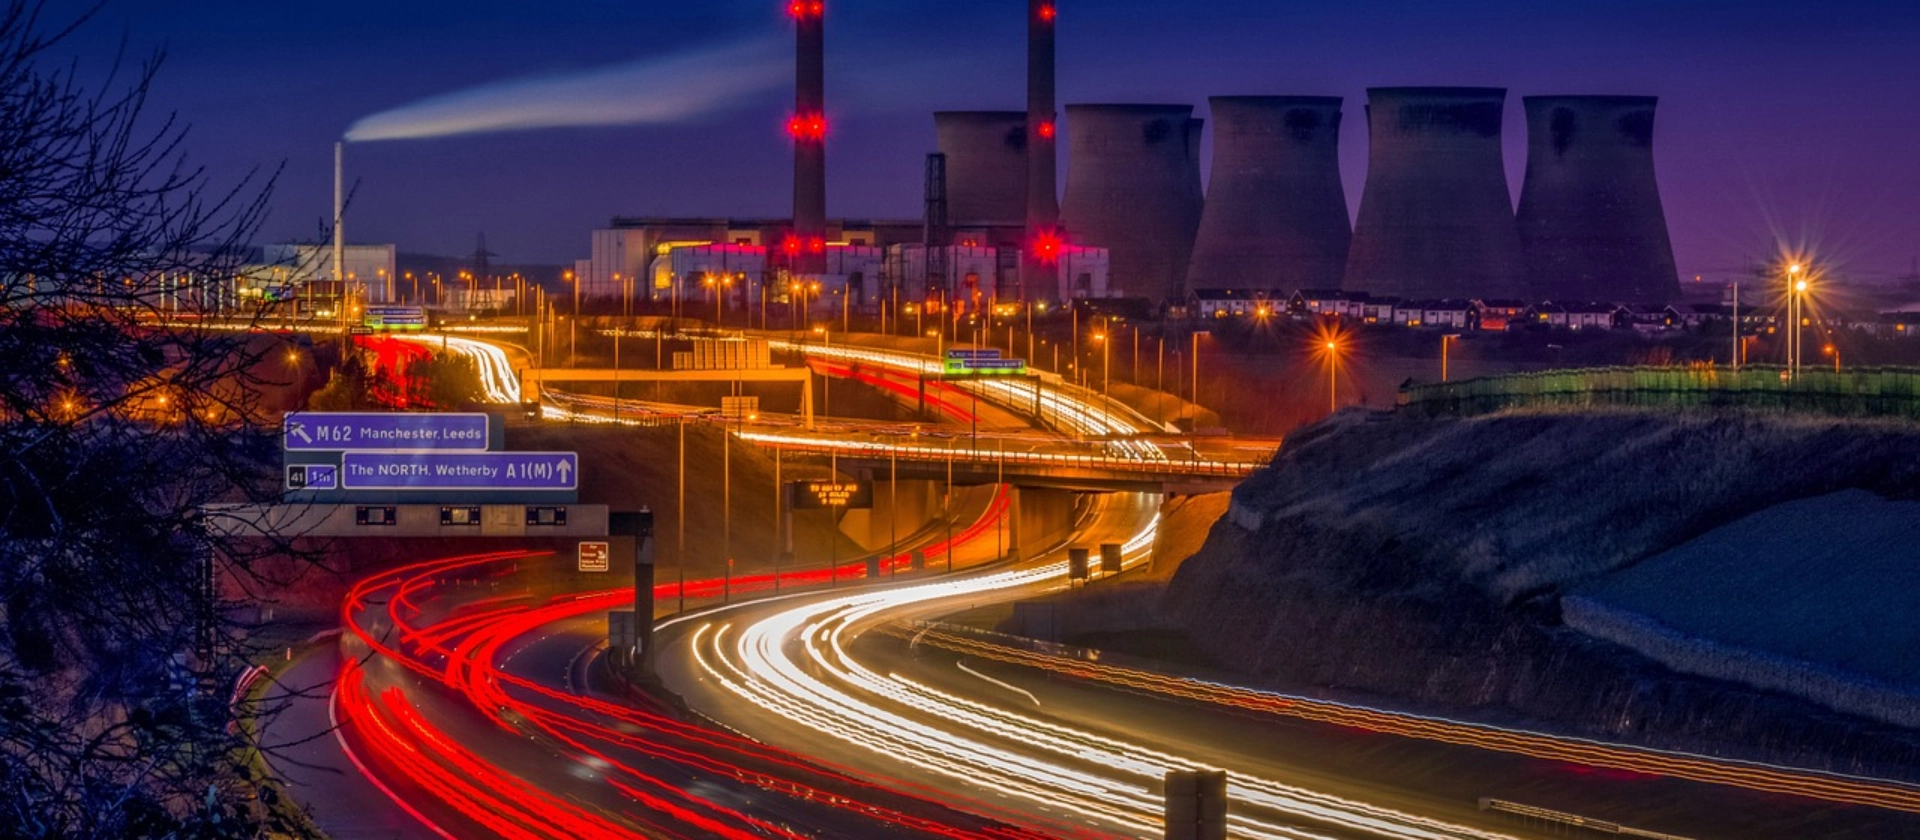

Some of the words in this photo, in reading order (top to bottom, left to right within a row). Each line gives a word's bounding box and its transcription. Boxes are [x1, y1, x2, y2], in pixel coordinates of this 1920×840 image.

[317, 426, 351, 441] M62
[443, 428, 481, 439] Leeds
[290, 472, 304, 482] 41
[350, 464, 374, 476] The
[436, 464, 498, 478] Wetherby
